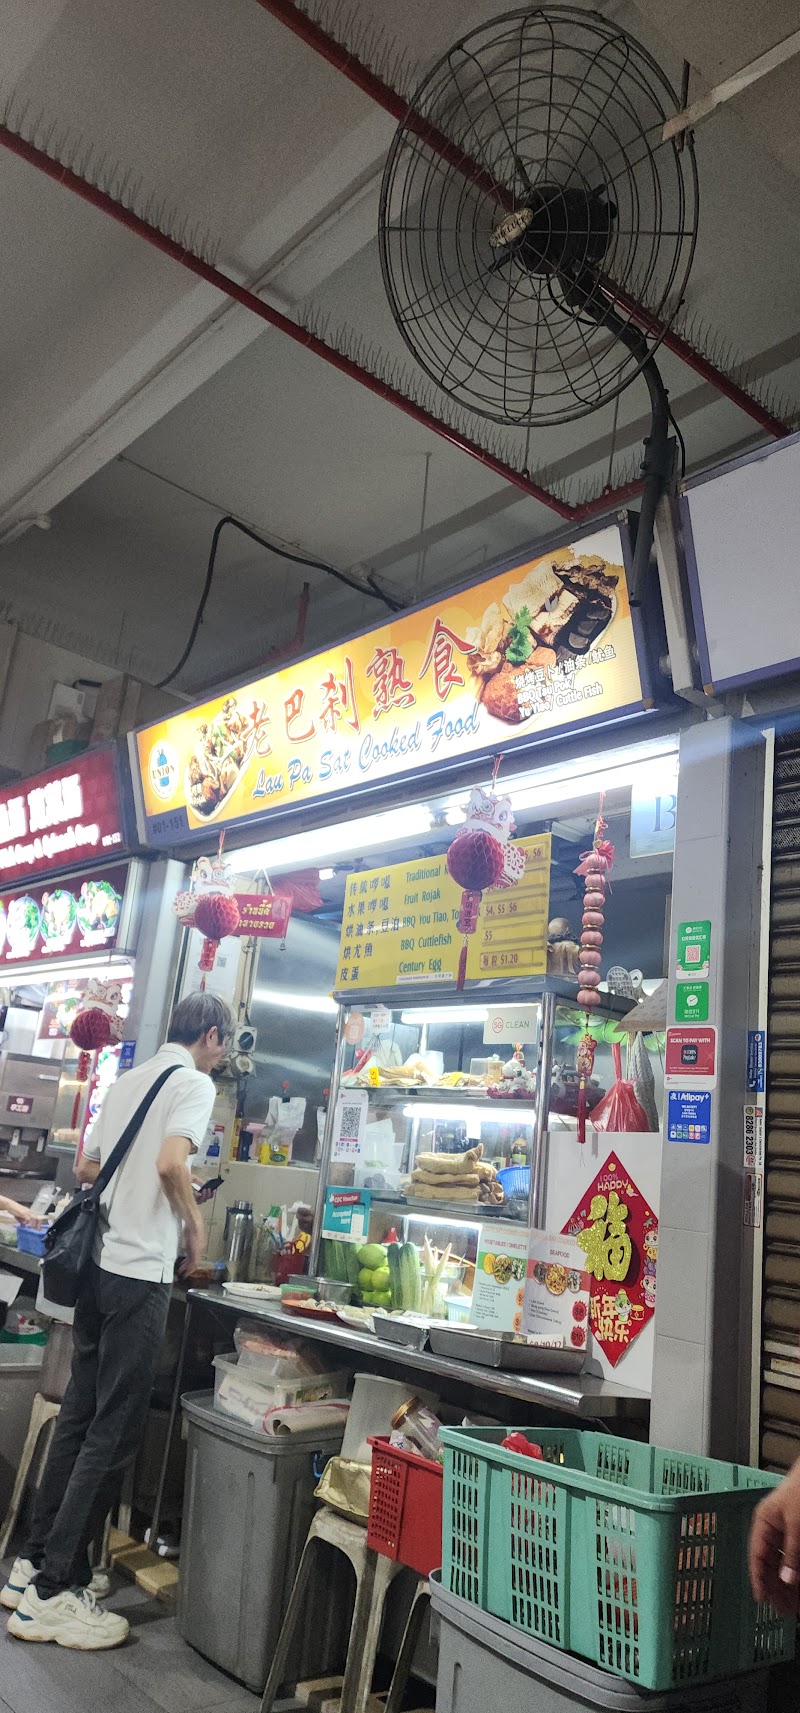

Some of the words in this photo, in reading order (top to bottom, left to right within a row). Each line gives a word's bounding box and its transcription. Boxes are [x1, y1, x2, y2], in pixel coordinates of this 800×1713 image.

[240, 616, 477, 758] 老巴刹熟食
[517, 687, 537, 705] BBQ
[536, 684, 553, 699] Tau
[518, 704, 532, 718] Yu
[556, 689, 583, 706] Cuttle
[583, 682, 604, 700] Fish
[253, 769, 284, 798] Lau
[287, 758, 313, 789] Pa
[319, 749, 352, 780] Sat
[358, 720, 423, 771] Cooked
[426, 702, 480, 752] Food
[152, 765, 175, 780] UNION
[406, 864, 441, 883] Traditional
[533, 847, 541, 858] $6
[404, 893, 419, 905] Fruit
[421, 887, 441, 902] Rojak
[402, 914, 416, 928] BBQ
[419, 912, 432, 926] You
[497, 904, 505, 914] $5
[509, 902, 517, 913] $6
[401, 937, 414, 951] BBQ
[418, 933, 452, 949] Cuttlefish
[485, 931, 493, 942] $5
[339, 966, 360, 982] 皮蛋
[399, 959, 425, 974] Century
[428, 957, 442, 973] Egg
[500, 953, 519, 966] $1.20
[505, 1020, 530, 1030] CLEAN
[745, 1115, 754, 1134] 8286
[745, 1136, 754, 1155] 2303
[597, 1178, 629, 1192] HAPPY
[600, 1173, 619, 1182] 100%
[577, 1191, 632, 1281] 福
[549, 1249, 570, 1259] SEAFOOD
